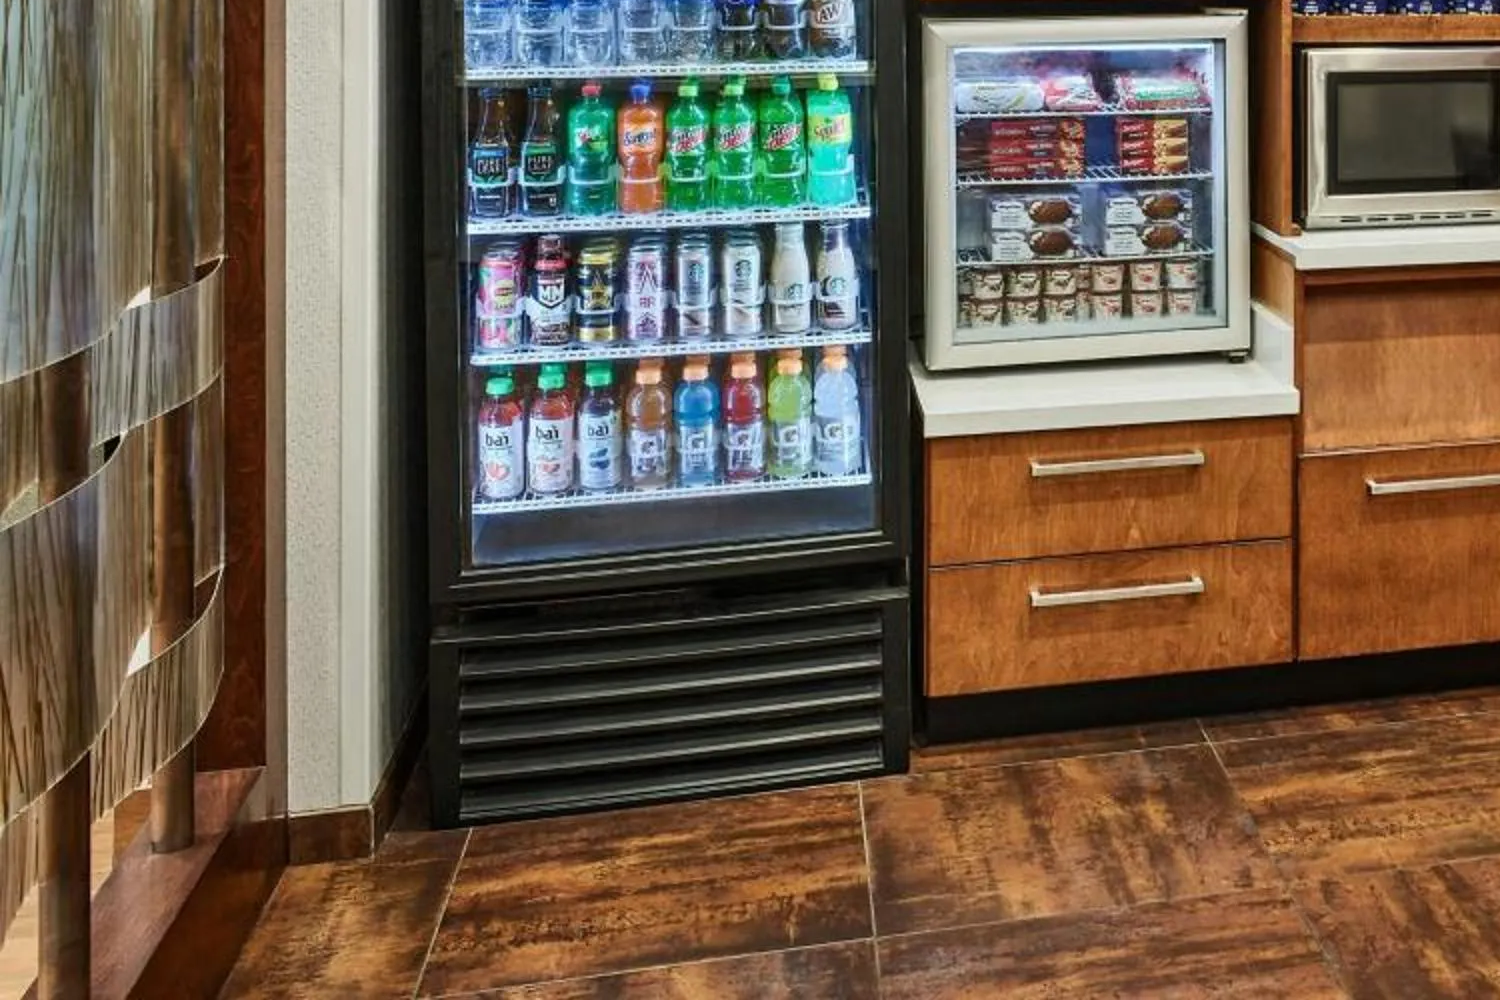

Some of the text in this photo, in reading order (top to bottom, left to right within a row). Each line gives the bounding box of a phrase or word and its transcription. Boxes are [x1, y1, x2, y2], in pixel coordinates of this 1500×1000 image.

[535, 425, 560, 440] bai
[587, 422, 609, 437] bai
[485, 433, 510, 447] bai
